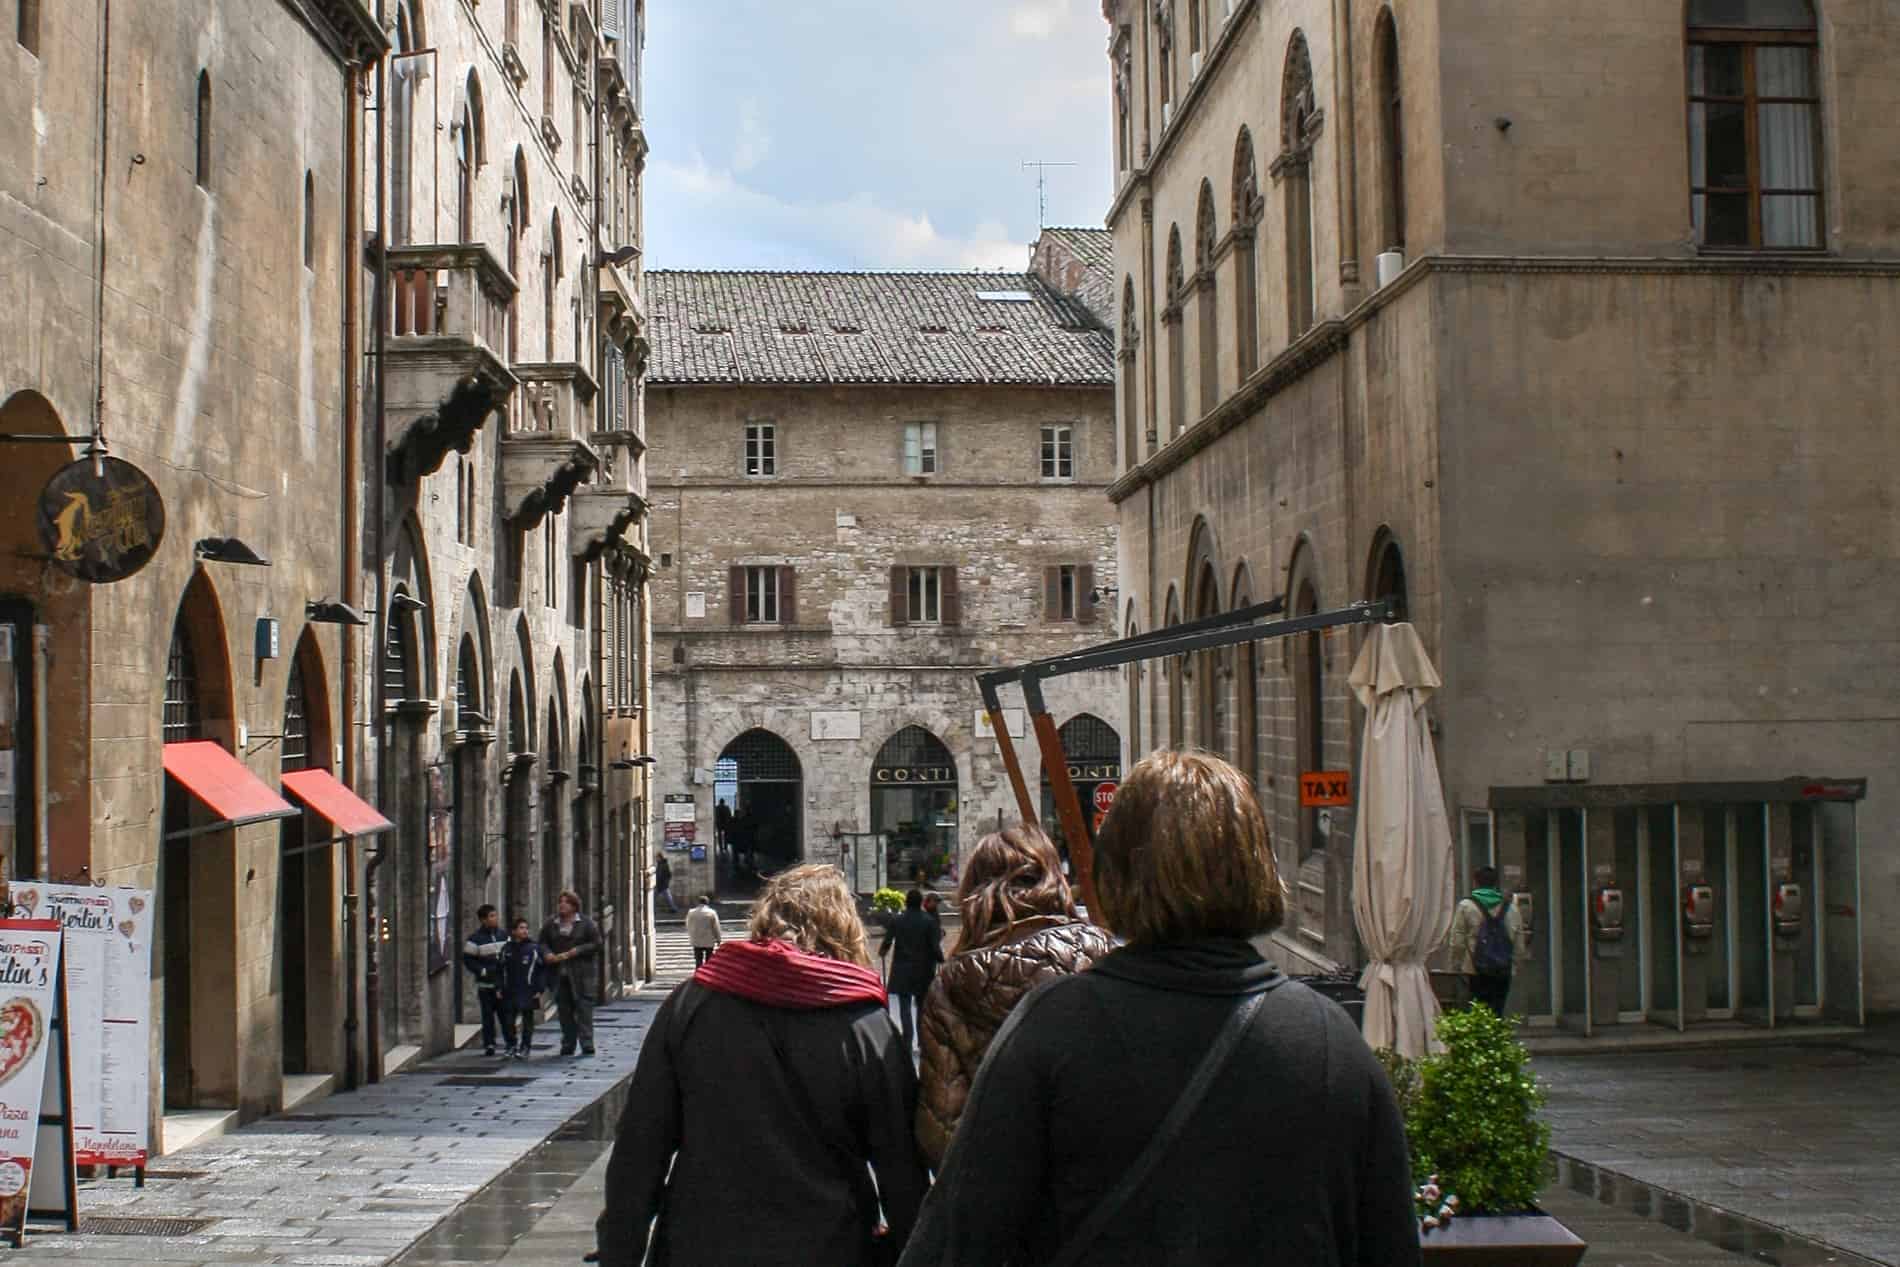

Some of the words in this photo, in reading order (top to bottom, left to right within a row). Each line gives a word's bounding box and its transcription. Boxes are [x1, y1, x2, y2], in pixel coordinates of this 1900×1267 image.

[877, 768, 949, 781] CONTI
[1067, 765, 1120, 778] ONTI
[1303, 781, 1348, 799] TAXI
[1095, 791, 1115, 804] STO
